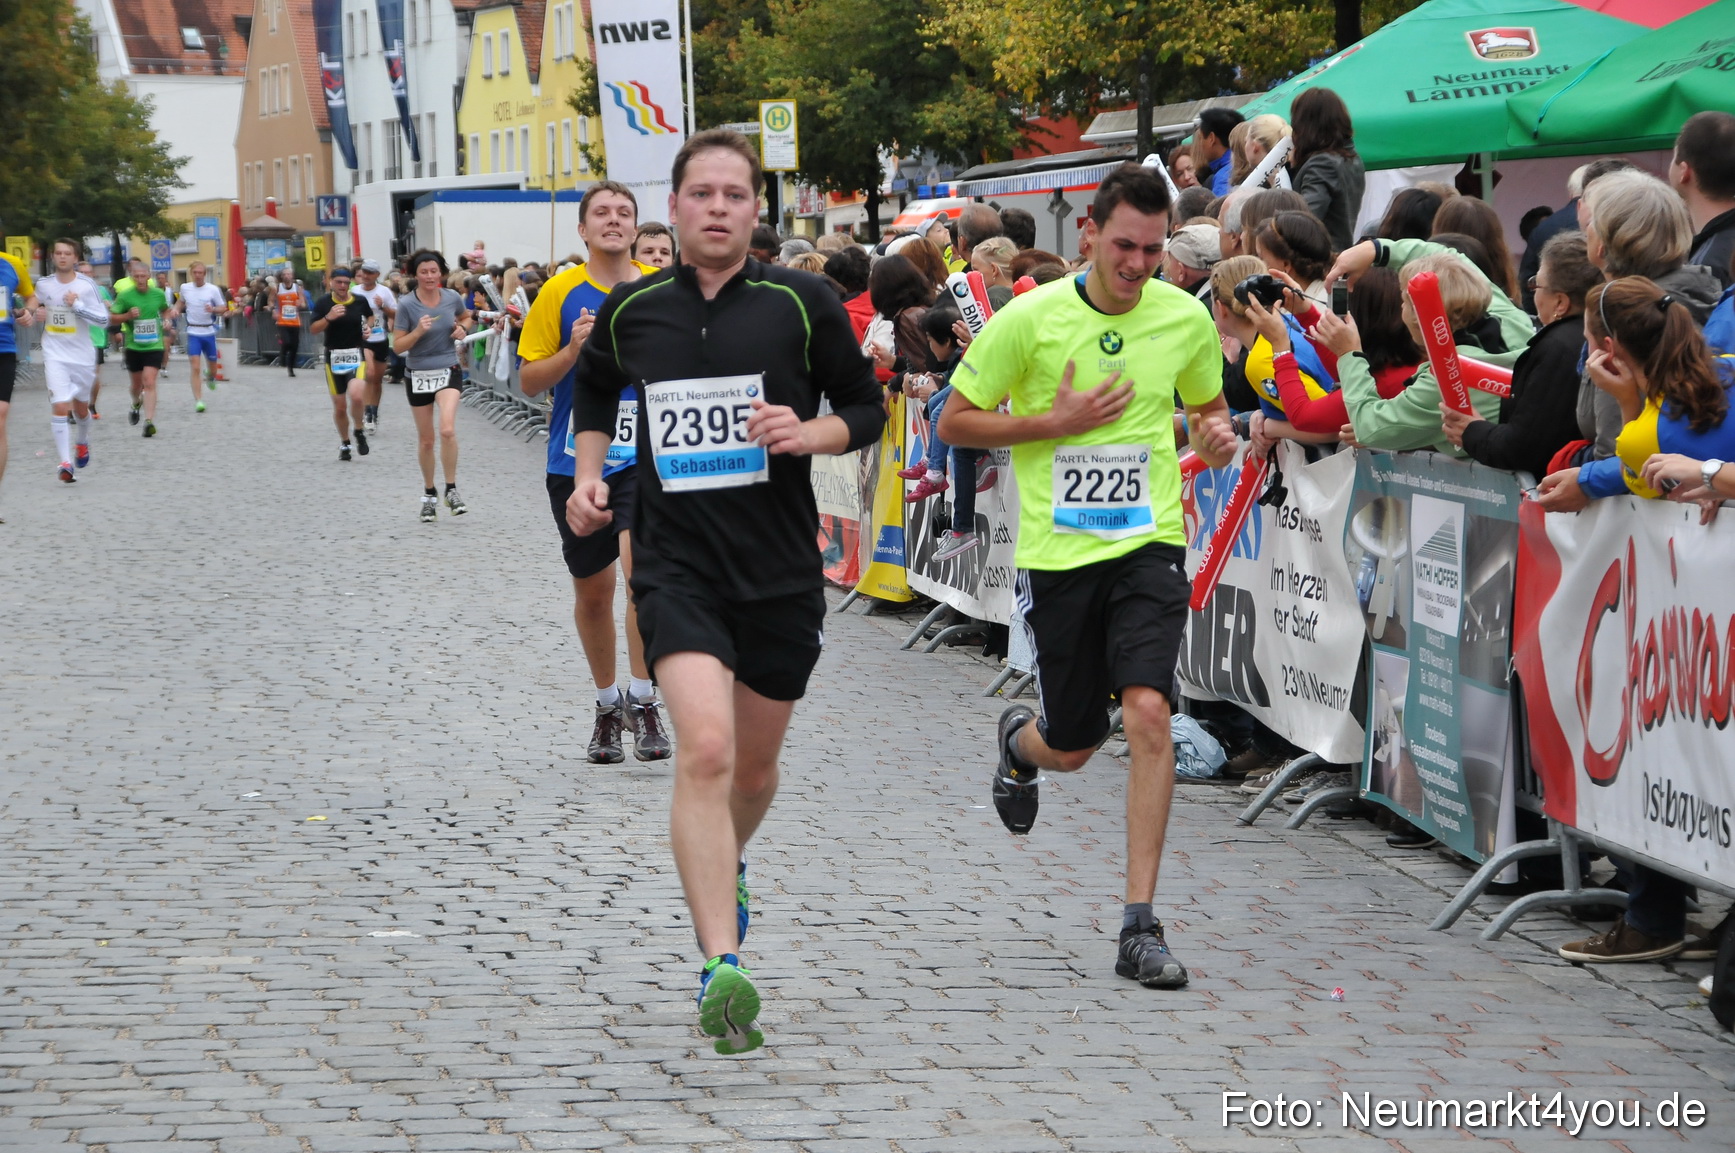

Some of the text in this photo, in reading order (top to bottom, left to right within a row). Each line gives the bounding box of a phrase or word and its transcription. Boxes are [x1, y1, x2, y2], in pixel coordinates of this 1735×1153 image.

[1495, 51, 1524, 59] 1628
[1405, 80, 1542, 104] Lamm
[493, 101, 512, 122] HOTEL
[311, 247, 322, 262] D
[153, 260, 170, 268] TAXI
[53, 314, 66, 325] 65
[334, 355, 358, 364] 2429
[1098, 358, 1126, 368] Partl
[417, 377, 446, 391] 2173
[1444, 353, 1469, 408] Audi BKK
[648, 388, 742, 404] PARTL Neumarkt
[660, 404, 752, 448] 2395
[670, 455, 746, 475] Sebastian
[1054, 453, 1137, 464] PARTL Neumarkt
[1063, 468, 1141, 503] 2225
[1213, 476, 1243, 535] Audi BKK
[1078, 511, 1130, 527] Dominik
[1270, 558, 1328, 602] Im Herzen
[1576, 535, 1735, 787] Chariva
